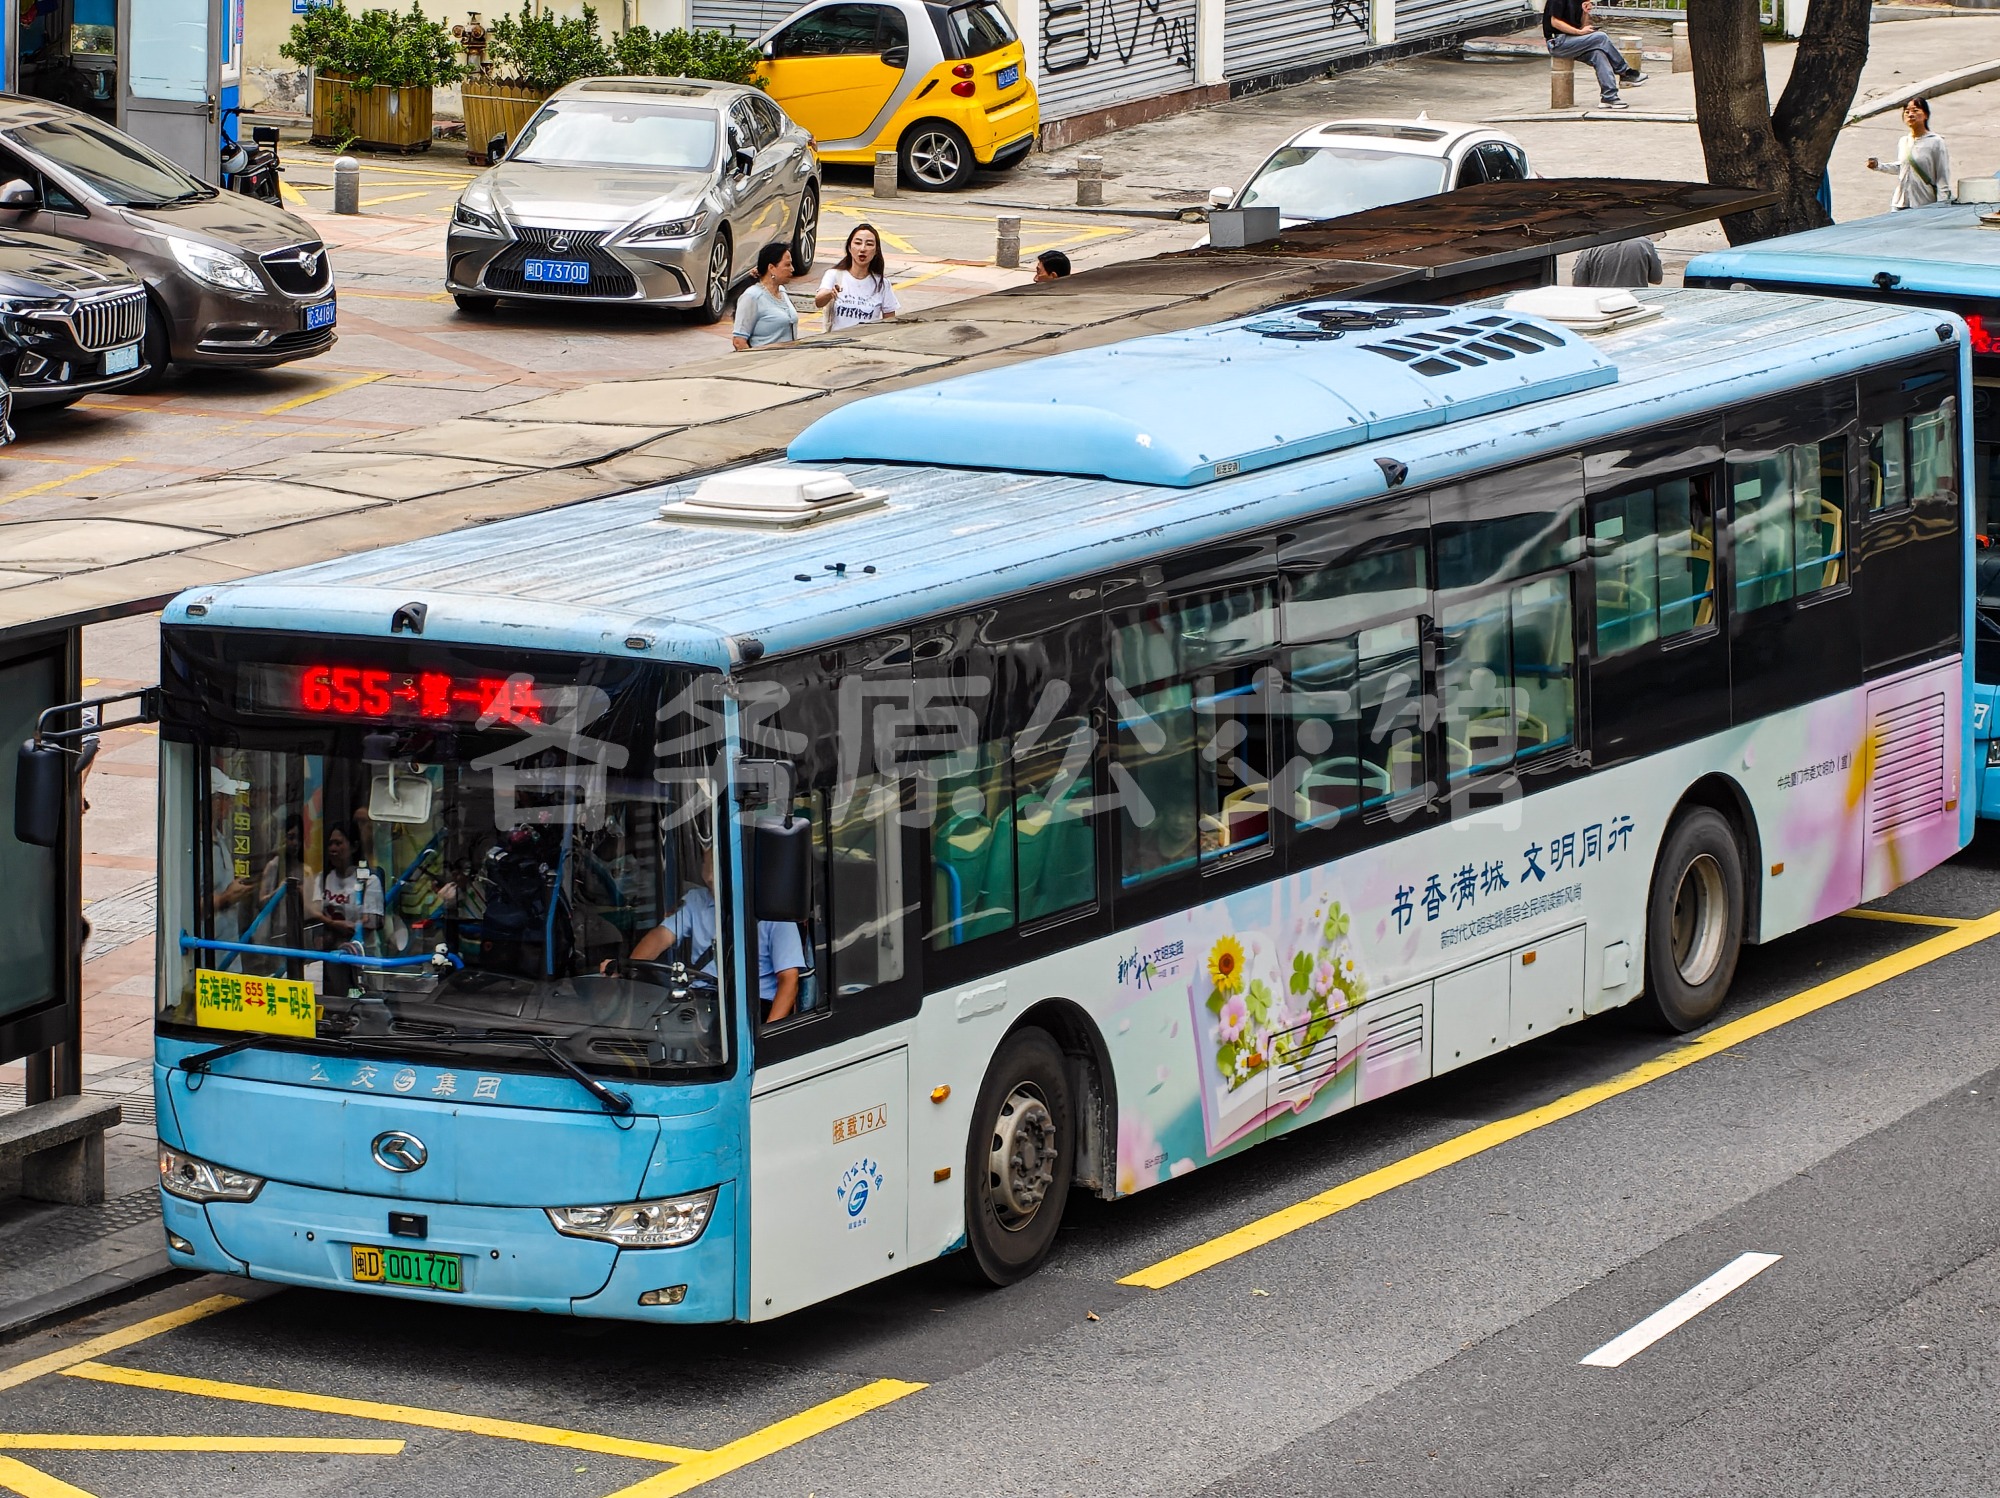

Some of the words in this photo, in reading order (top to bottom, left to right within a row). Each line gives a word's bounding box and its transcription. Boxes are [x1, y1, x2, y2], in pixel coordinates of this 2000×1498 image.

[303, 666, 392, 716] 655
[1391, 861, 1510, 934] 书香满城
[1520, 815, 1635, 883] 文明同行
[200, 974, 243, 1012] 东海学院
[244, 981, 264, 997] 655
[266, 982, 311, 1019] 第一码头
[834, 1107, 886, 1141] 核载79人
